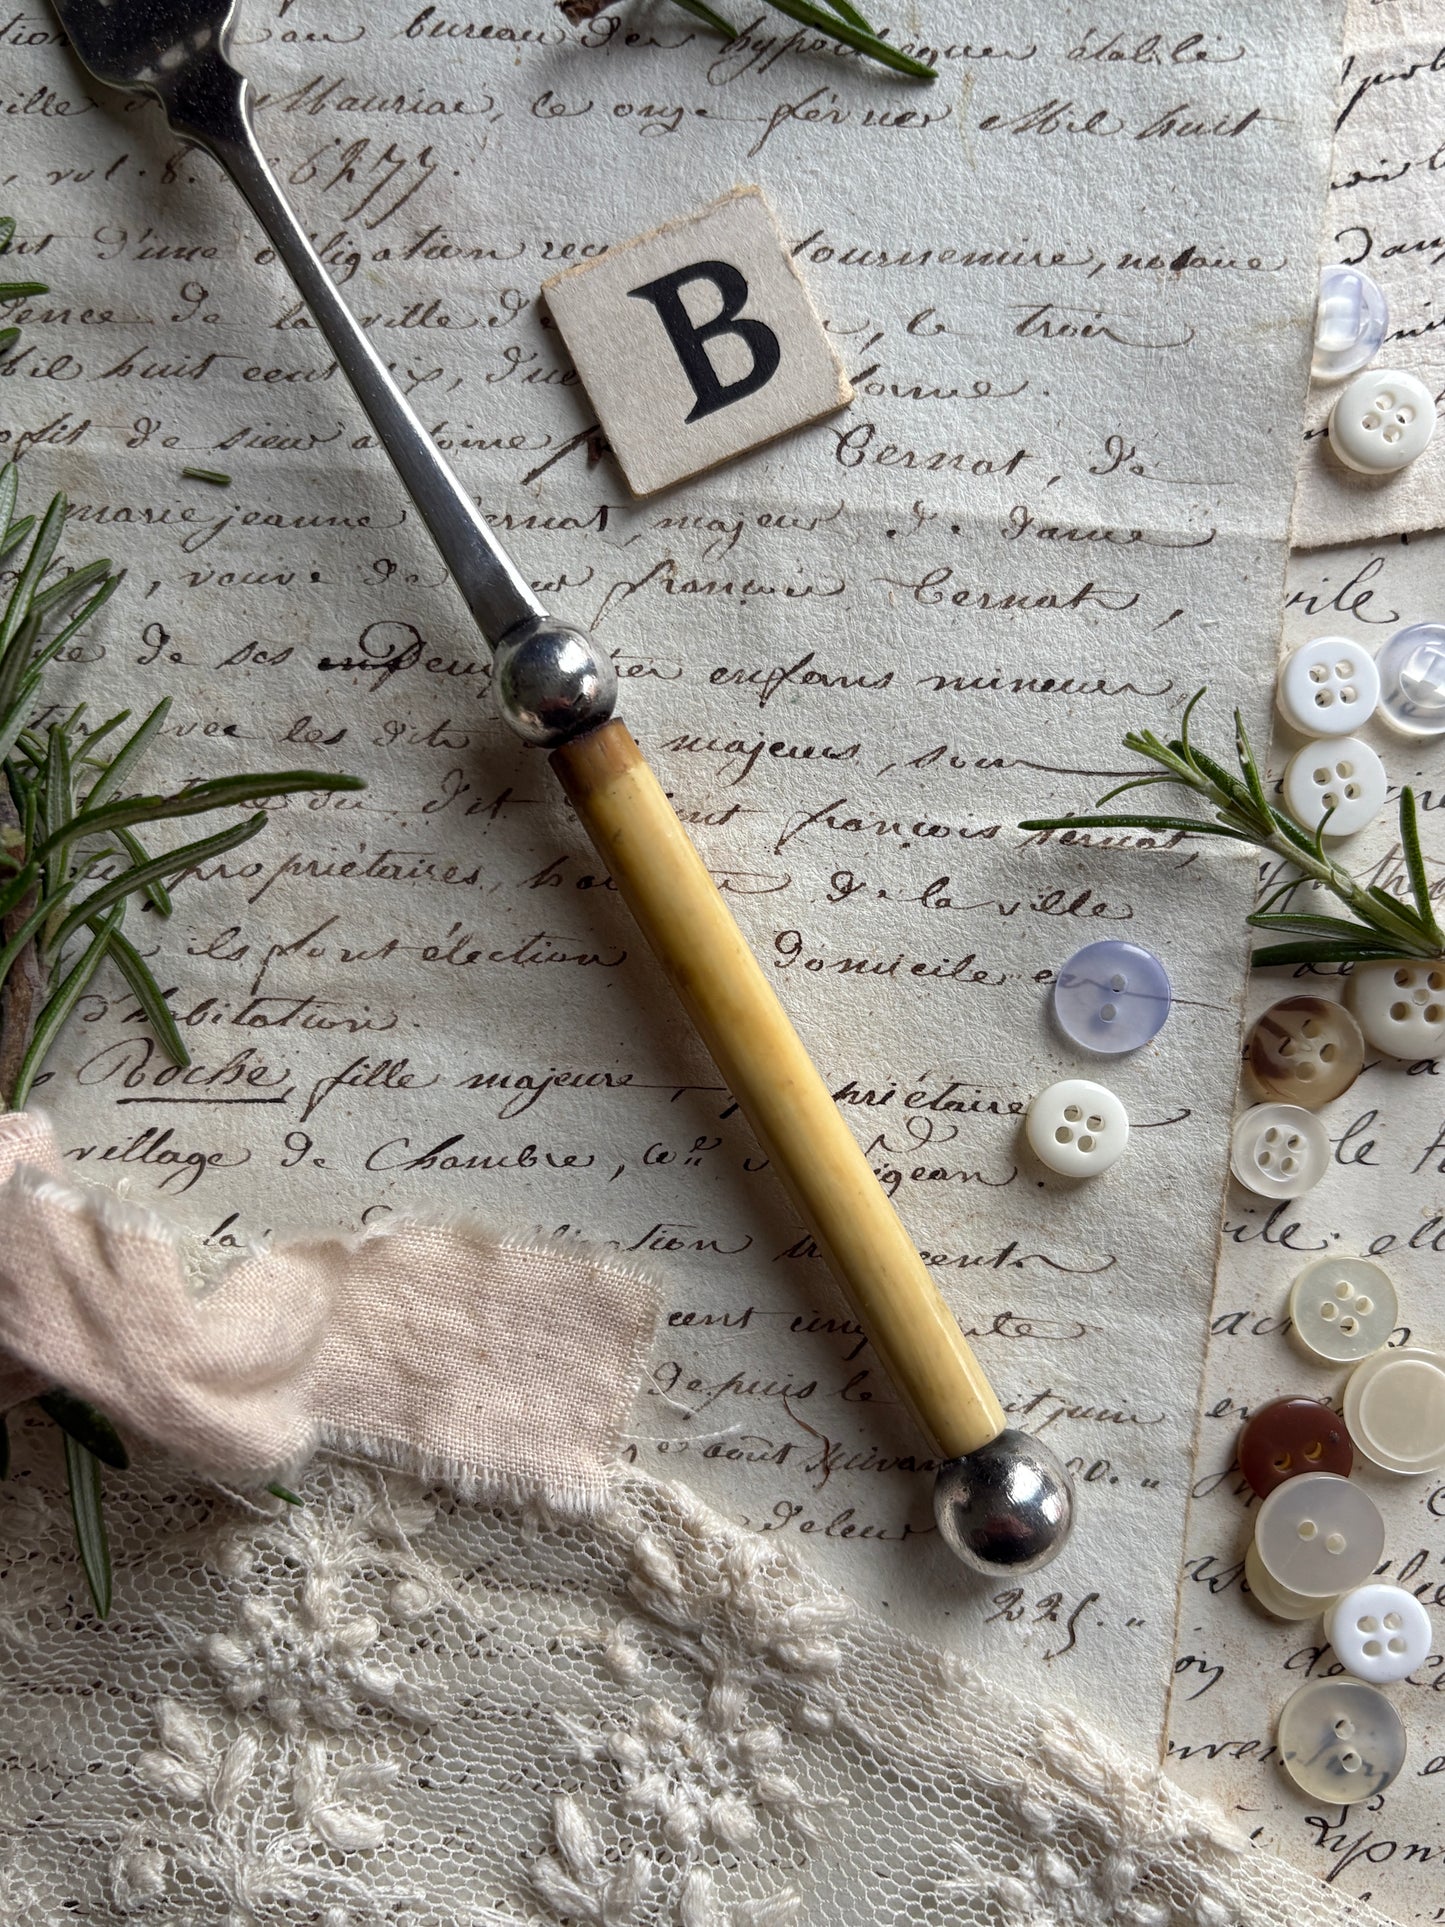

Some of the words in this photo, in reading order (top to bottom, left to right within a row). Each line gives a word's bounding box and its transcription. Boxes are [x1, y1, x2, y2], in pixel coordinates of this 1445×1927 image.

[396, 5, 565, 46] bureau
[531, 90, 594, 118] le
[1134, 103, 1296, 141] huit
[173, 281, 240, 325] de
[360, 299, 480, 330] ville
[627, 258, 782, 426] B
[87, 345, 250, 382] huit
[126, 416, 225, 450] de
[138, 622, 203, 664] de
[280, 715, 350, 745] les
[998, 888, 1133, 921] ville
[301, 1054, 442, 1122] fille
[62, 1126, 252, 1196] village
[281, 1131, 330, 1171] de
